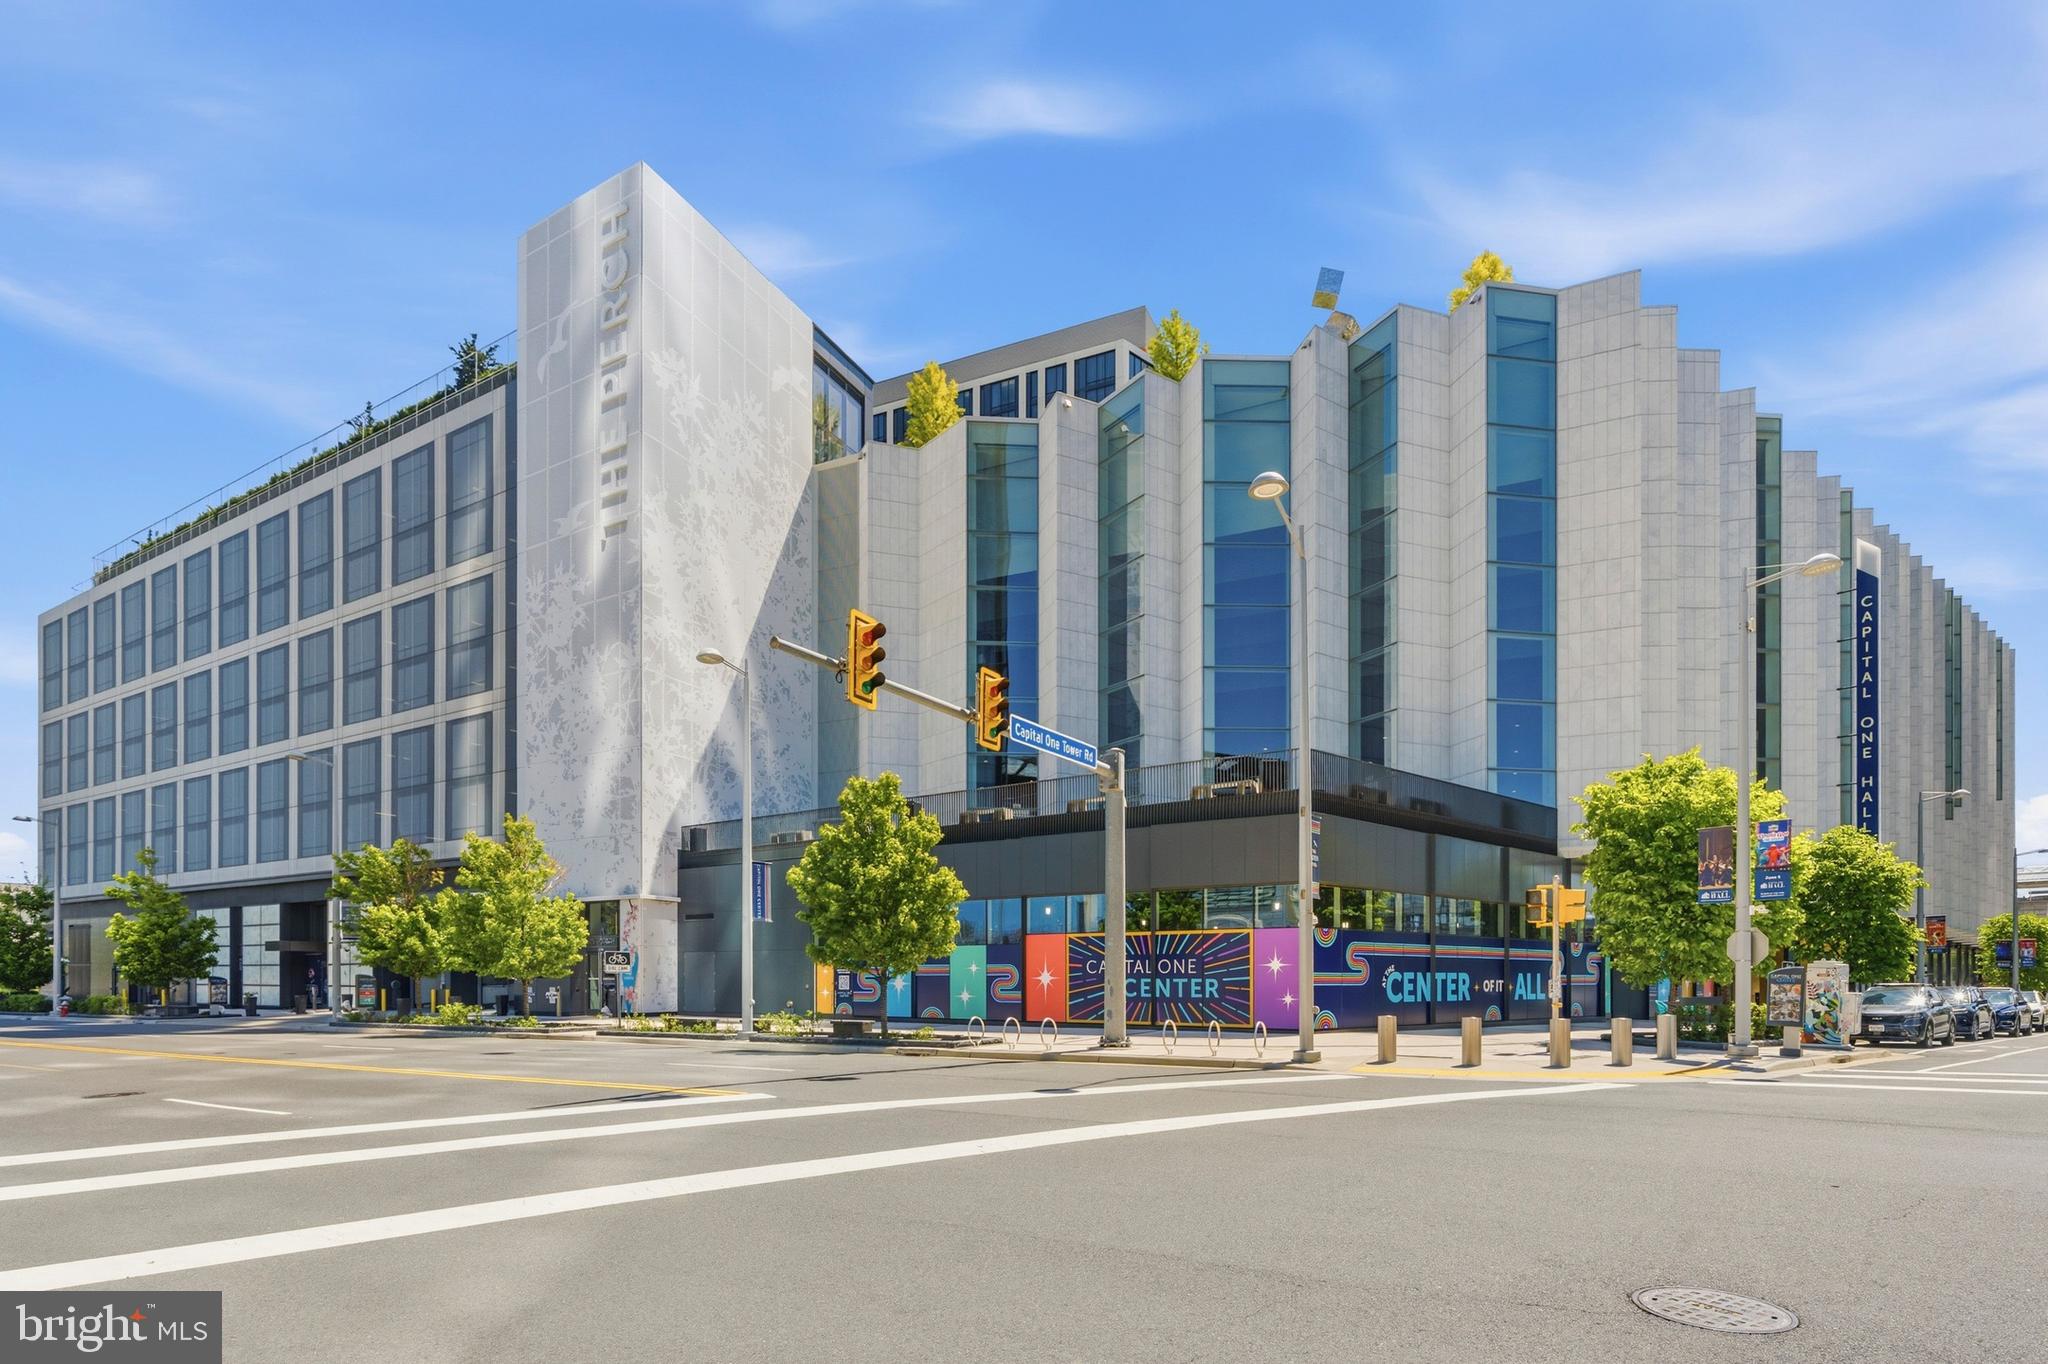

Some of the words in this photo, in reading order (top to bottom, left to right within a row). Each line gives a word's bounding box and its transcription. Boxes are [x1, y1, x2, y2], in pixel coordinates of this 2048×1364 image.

[600, 200, 629, 413] PERCH
[600, 419, 628, 551] THE
[1860, 595, 1873, 698] CAPITAL
[1015, 723, 1043, 744] Capital
[1045, 734, 1060, 750] One
[1062, 740, 1082, 758] Tower
[1084, 748, 1094, 762] Rd
[1860, 716, 1874, 759] ONE
[1861, 775, 1873, 833] HALL
[1086, 959, 1151, 974] CATAL
[1157, 958, 1197, 974] ONE
[1125, 977, 1219, 998] CENTER
[1386, 971, 1471, 1003] CENTER
[1483, 979, 1494, 993] OF
[1495, 979, 1504, 992] IT
[1514, 972, 1546, 1000] ALL
